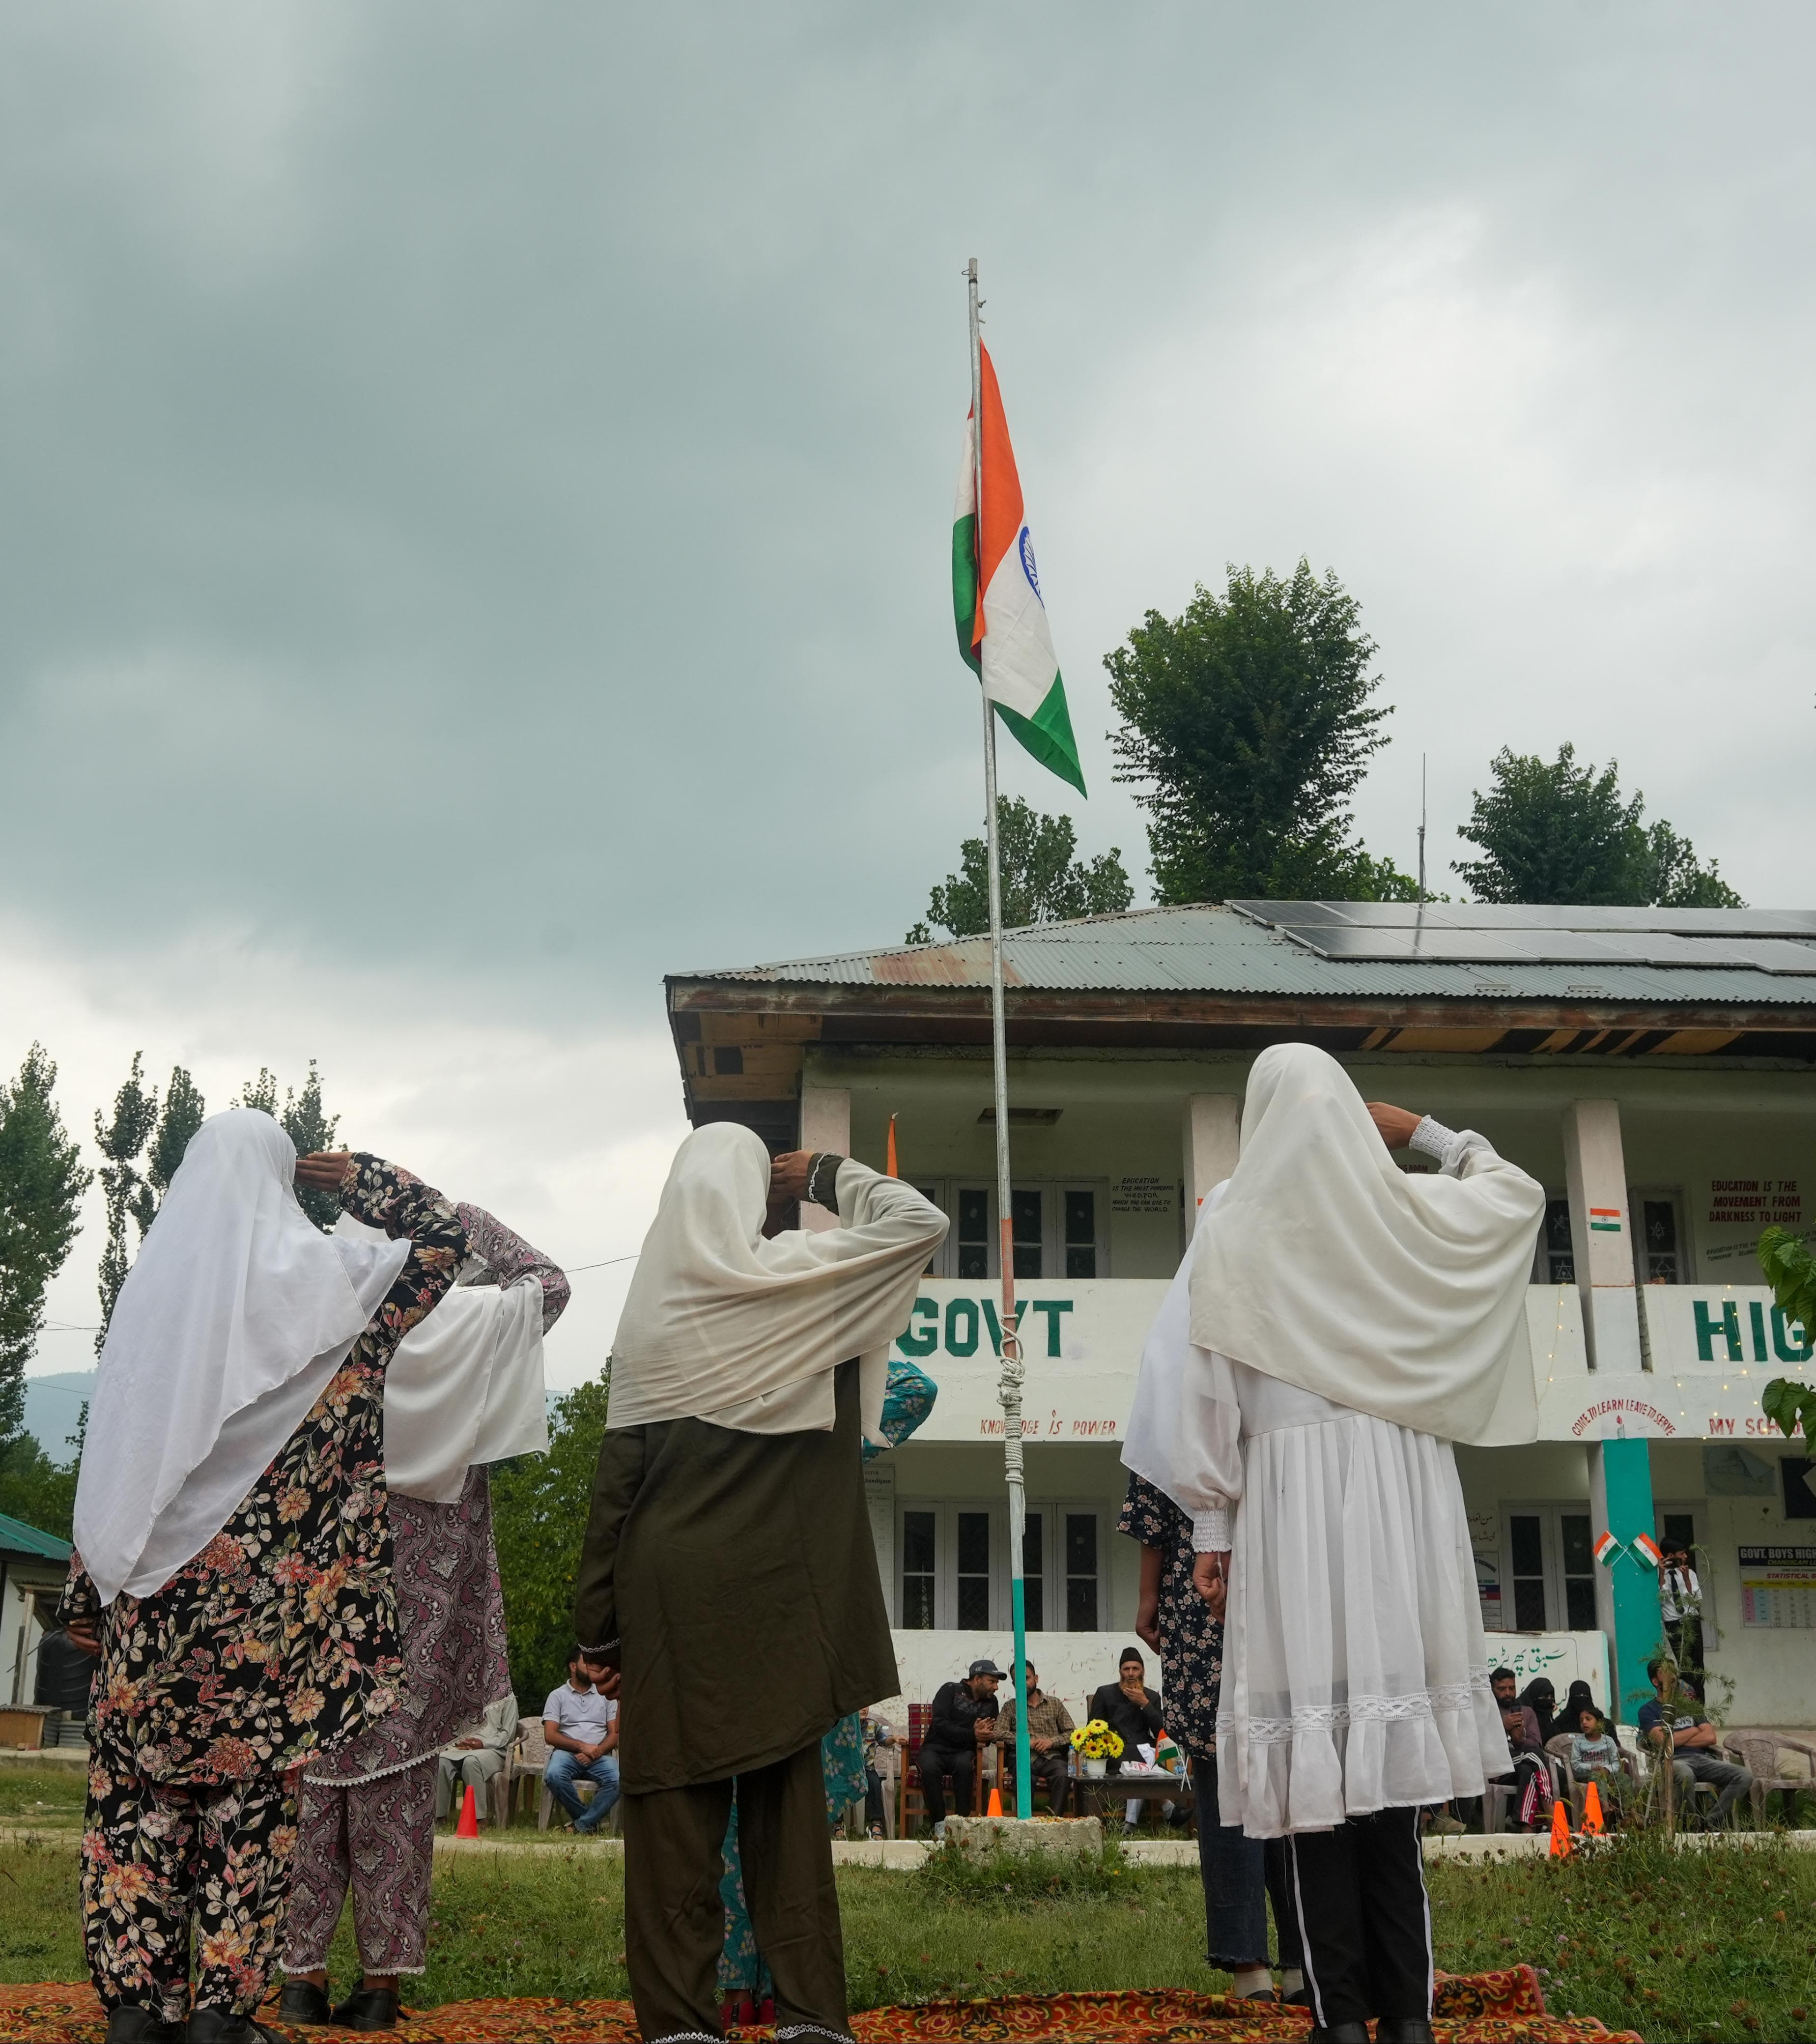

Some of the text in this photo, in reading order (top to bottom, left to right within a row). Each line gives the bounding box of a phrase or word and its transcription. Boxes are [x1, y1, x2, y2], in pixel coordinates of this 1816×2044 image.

[1712, 1181, 1797, 1192] EDUCATION IS THE
[1713, 1196, 1800, 1207] MOVEMENT FROM
[1709, 1211, 1801, 1222] DARKNESS TO LIGHT
[896, 1298, 1073, 1357] GOVT
[1572, 1399, 1676, 1436] COME TO LEARN LEAVE TO SERVE
[980, 1419, 1039, 1434] KNODGE
[1072, 1420, 1116, 1435] POWER
[1709, 1418, 1735, 1435] MY
[1740, 1548, 1767, 1559] GOVT.
[1768, 1548, 1793, 1559] BOYS
